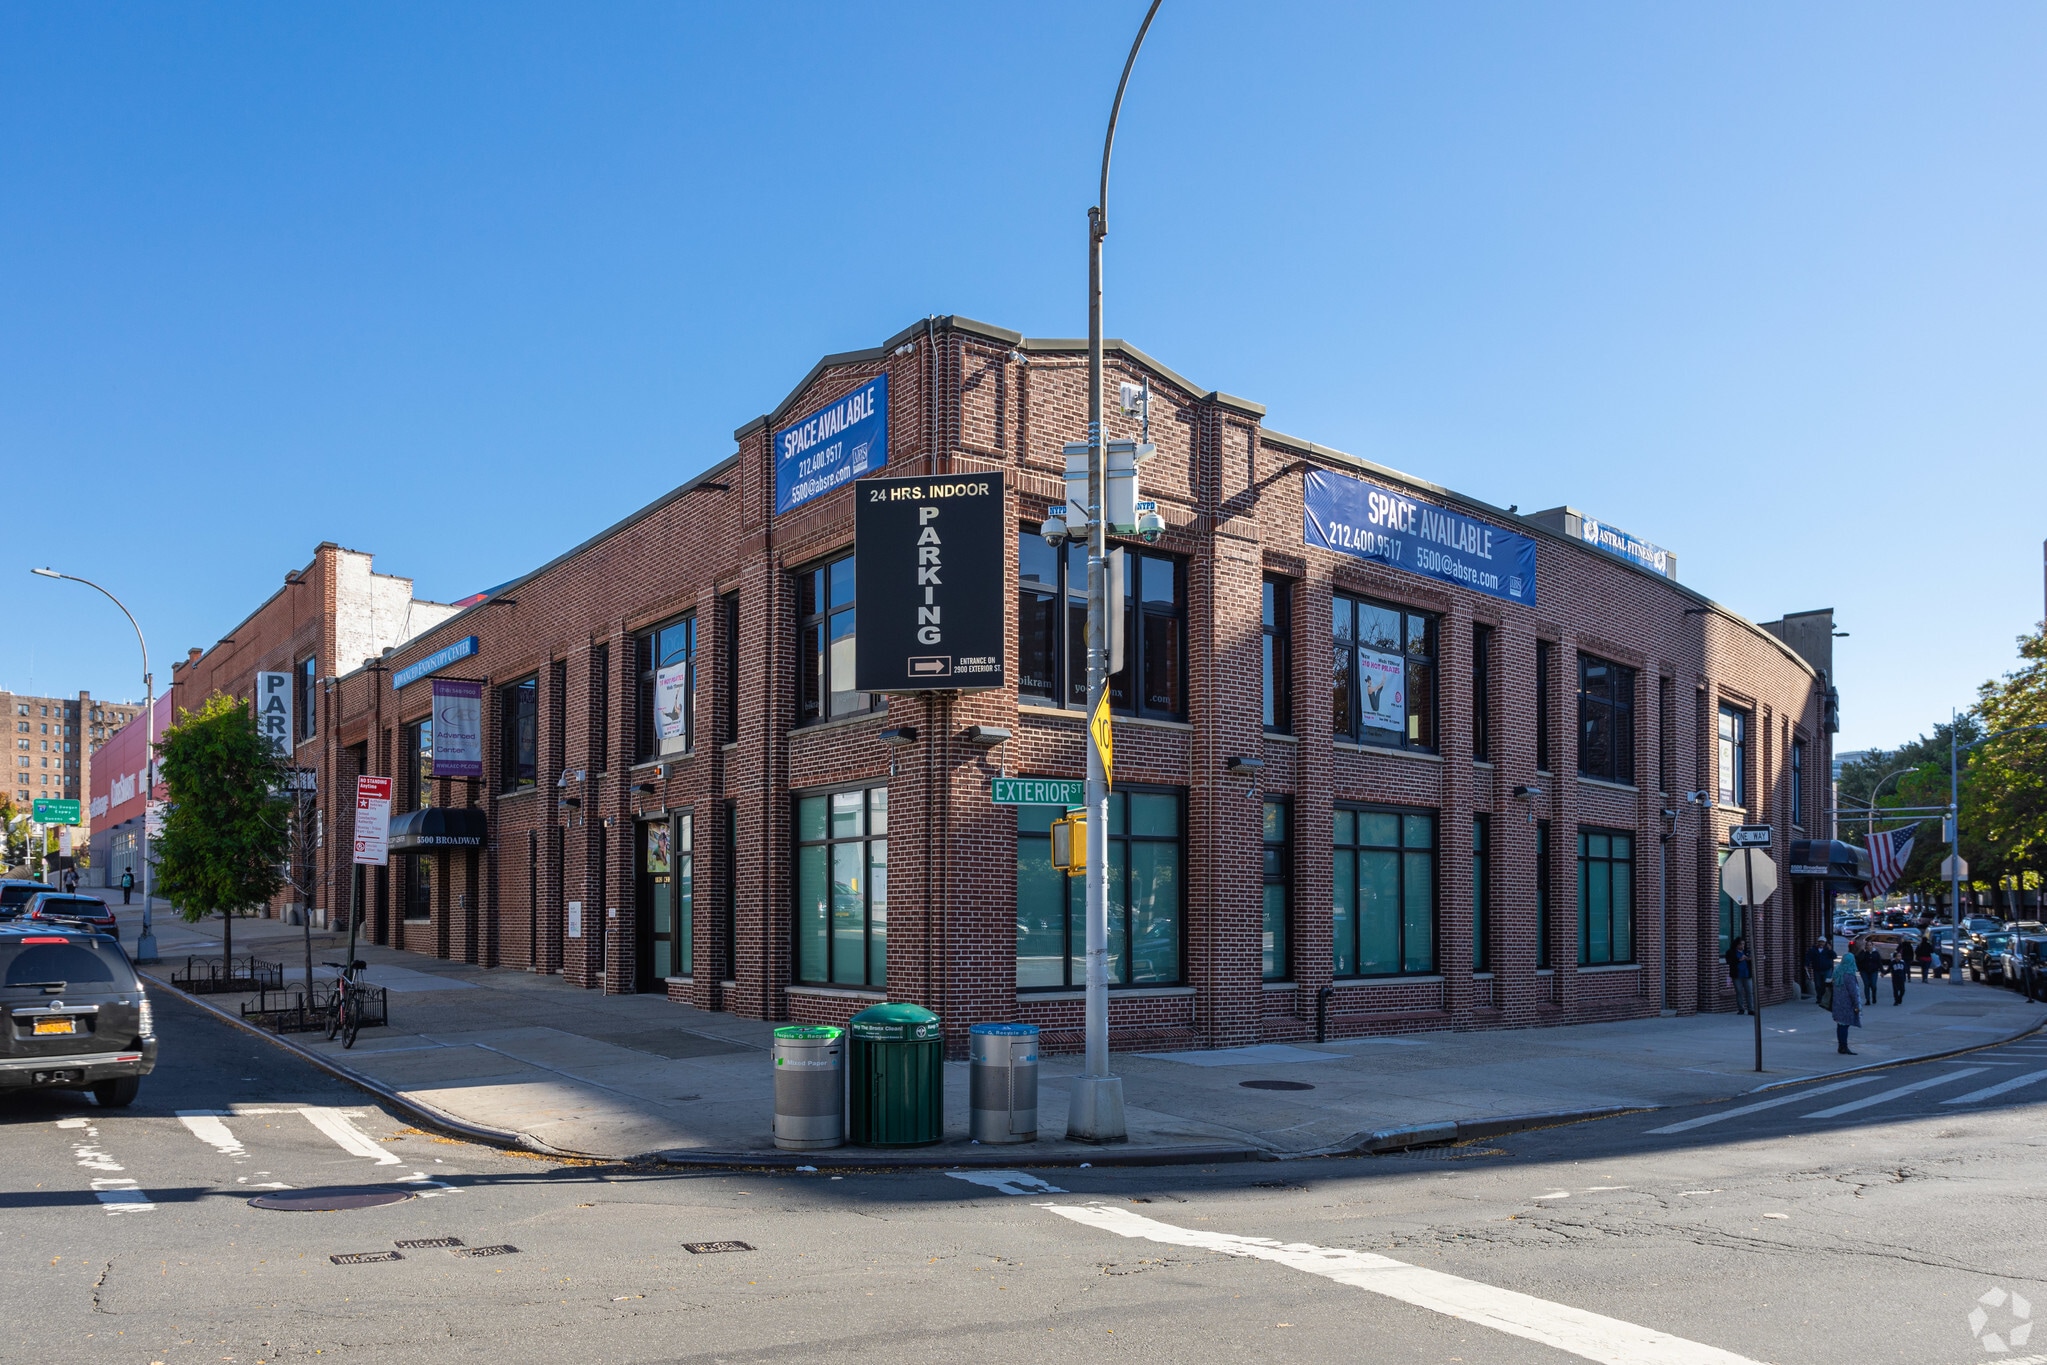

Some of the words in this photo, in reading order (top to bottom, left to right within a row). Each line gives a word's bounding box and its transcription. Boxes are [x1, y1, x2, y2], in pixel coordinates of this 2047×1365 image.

[785, 419, 817, 458] SPACE
[818, 386, 875, 442] AVAILABLE
[799, 441, 842, 478] 212.400.9517
[792, 465, 851, 504] 5500@absre.com
[870, 489, 887, 502] 24
[890, 487, 926, 500] HRS.
[929, 483, 989, 498] INDOOR
[1049, 506, 1067, 515] NYPD
[1137, 501, 1155, 510] NYPD
[1368, 491, 1417, 537] SPACE
[1420, 509, 1493, 560] AVAILABLE
[1329, 521, 1402, 561] 212.400.9517
[1417, 546, 1498, 590] 5500@absre.com
[1599, 529, 1627, 551] ASTRAL
[1627, 540, 1654, 562] FITNESS
[917, 506, 942, 645] PARKING
[447, 640, 470, 661] CENTER
[960, 657, 987, 665] ENTRANCE
[988, 656, 996, 664] ON
[968, 665, 993, 673] EXTERIOR
[994, 664, 1002, 672] ST.
[437, 731, 476, 740] Advanced
[996, 781, 1070, 803] EXTERIOR
[1070, 783, 1082, 794] ST
[416, 836, 434, 844] 5500
[435, 836, 480, 844] BROADWAY
[1737, 832, 1748, 840] ONE
[1753, 831, 1767, 840] WAY
